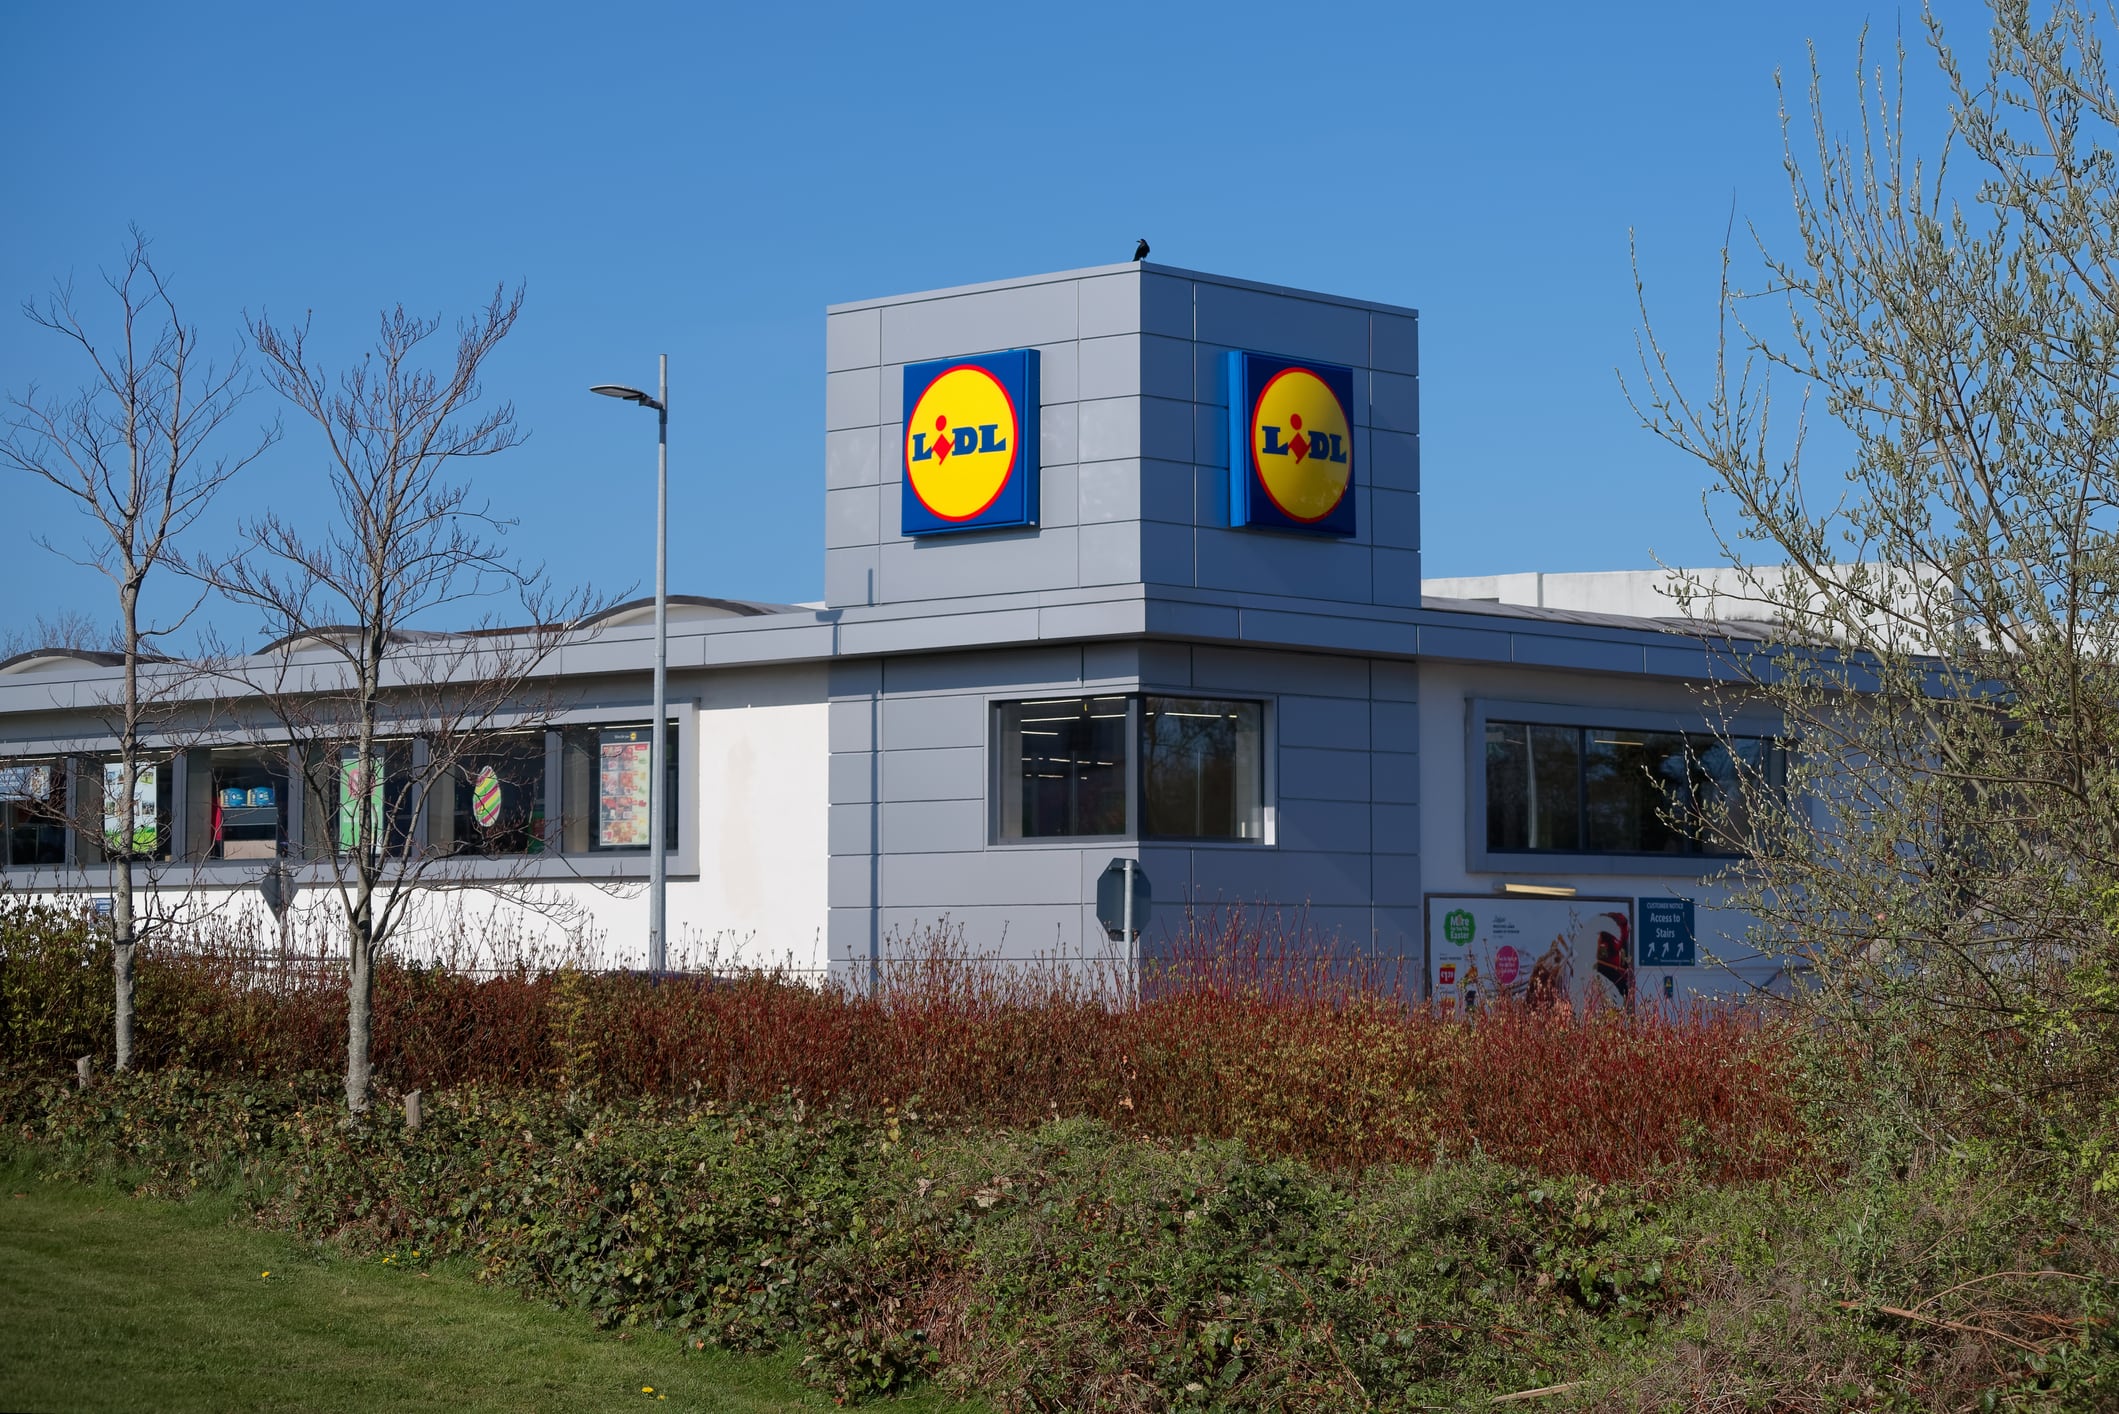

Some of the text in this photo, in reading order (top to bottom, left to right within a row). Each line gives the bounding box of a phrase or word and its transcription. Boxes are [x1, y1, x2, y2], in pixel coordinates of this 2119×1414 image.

[1650, 912, 1681, 923] Access to
[1450, 930, 1470, 939] Easter
[1655, 927, 1676, 938] Stairs
